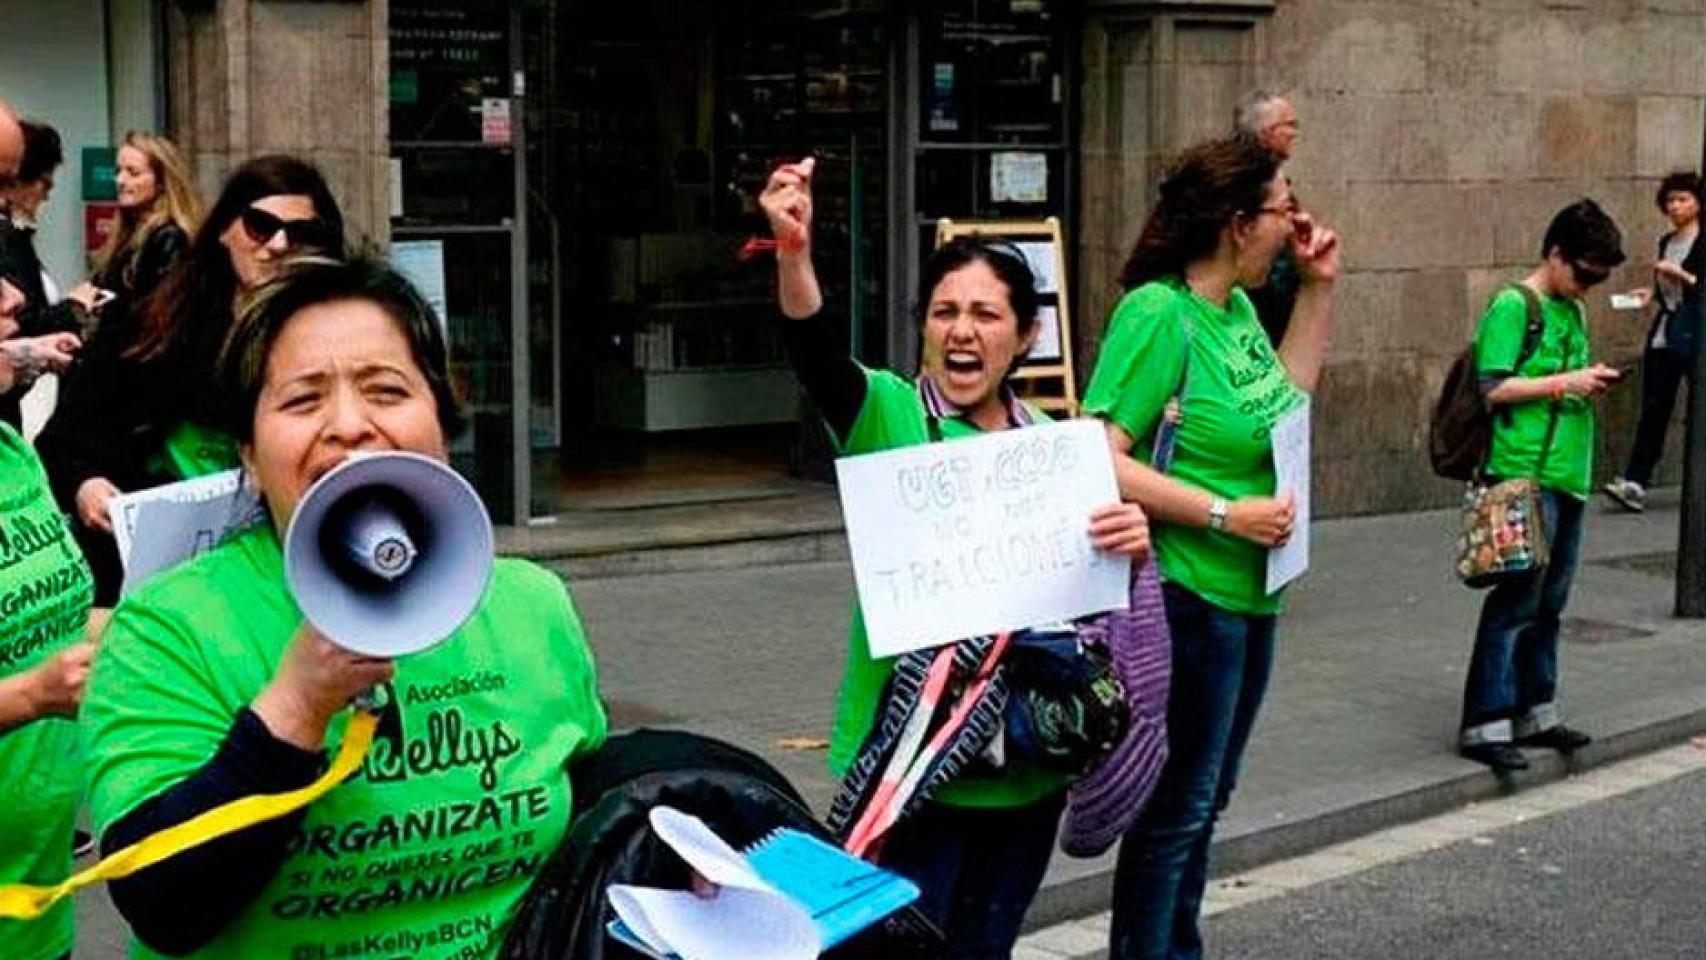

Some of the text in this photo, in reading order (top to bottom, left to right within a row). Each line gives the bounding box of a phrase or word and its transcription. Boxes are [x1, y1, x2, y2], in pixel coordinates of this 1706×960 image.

[407, 671, 506, 704] Asociación
[324, 859, 356, 885] NO
[365, 847, 453, 878] QUIERES
[461, 837, 503, 863] QUE
[512, 829, 535, 849] TE
[272, 852, 542, 920] ORGANICEN
